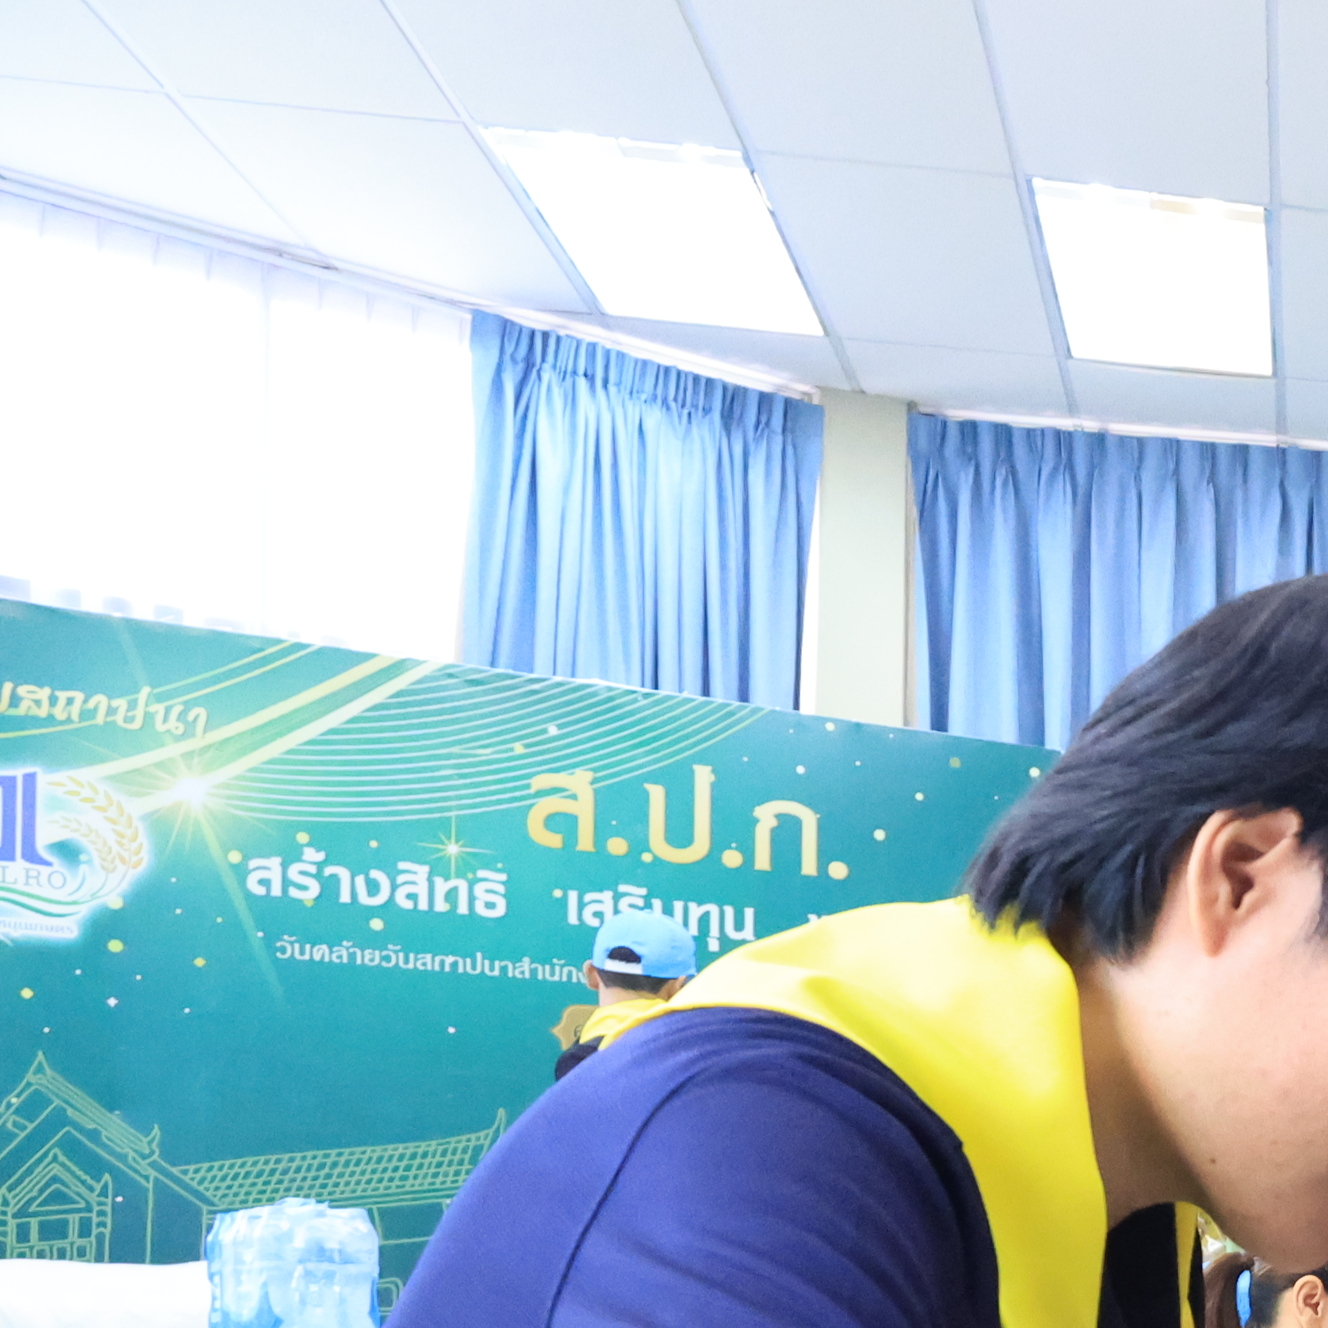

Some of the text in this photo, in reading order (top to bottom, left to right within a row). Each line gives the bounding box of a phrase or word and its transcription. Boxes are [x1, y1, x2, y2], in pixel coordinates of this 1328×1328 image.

[526, 763, 850, 881] ส.ป.ก.
[0, 865, 67, 890] LRO
[245, 846, 509, 919] สร้างสิทธิ
